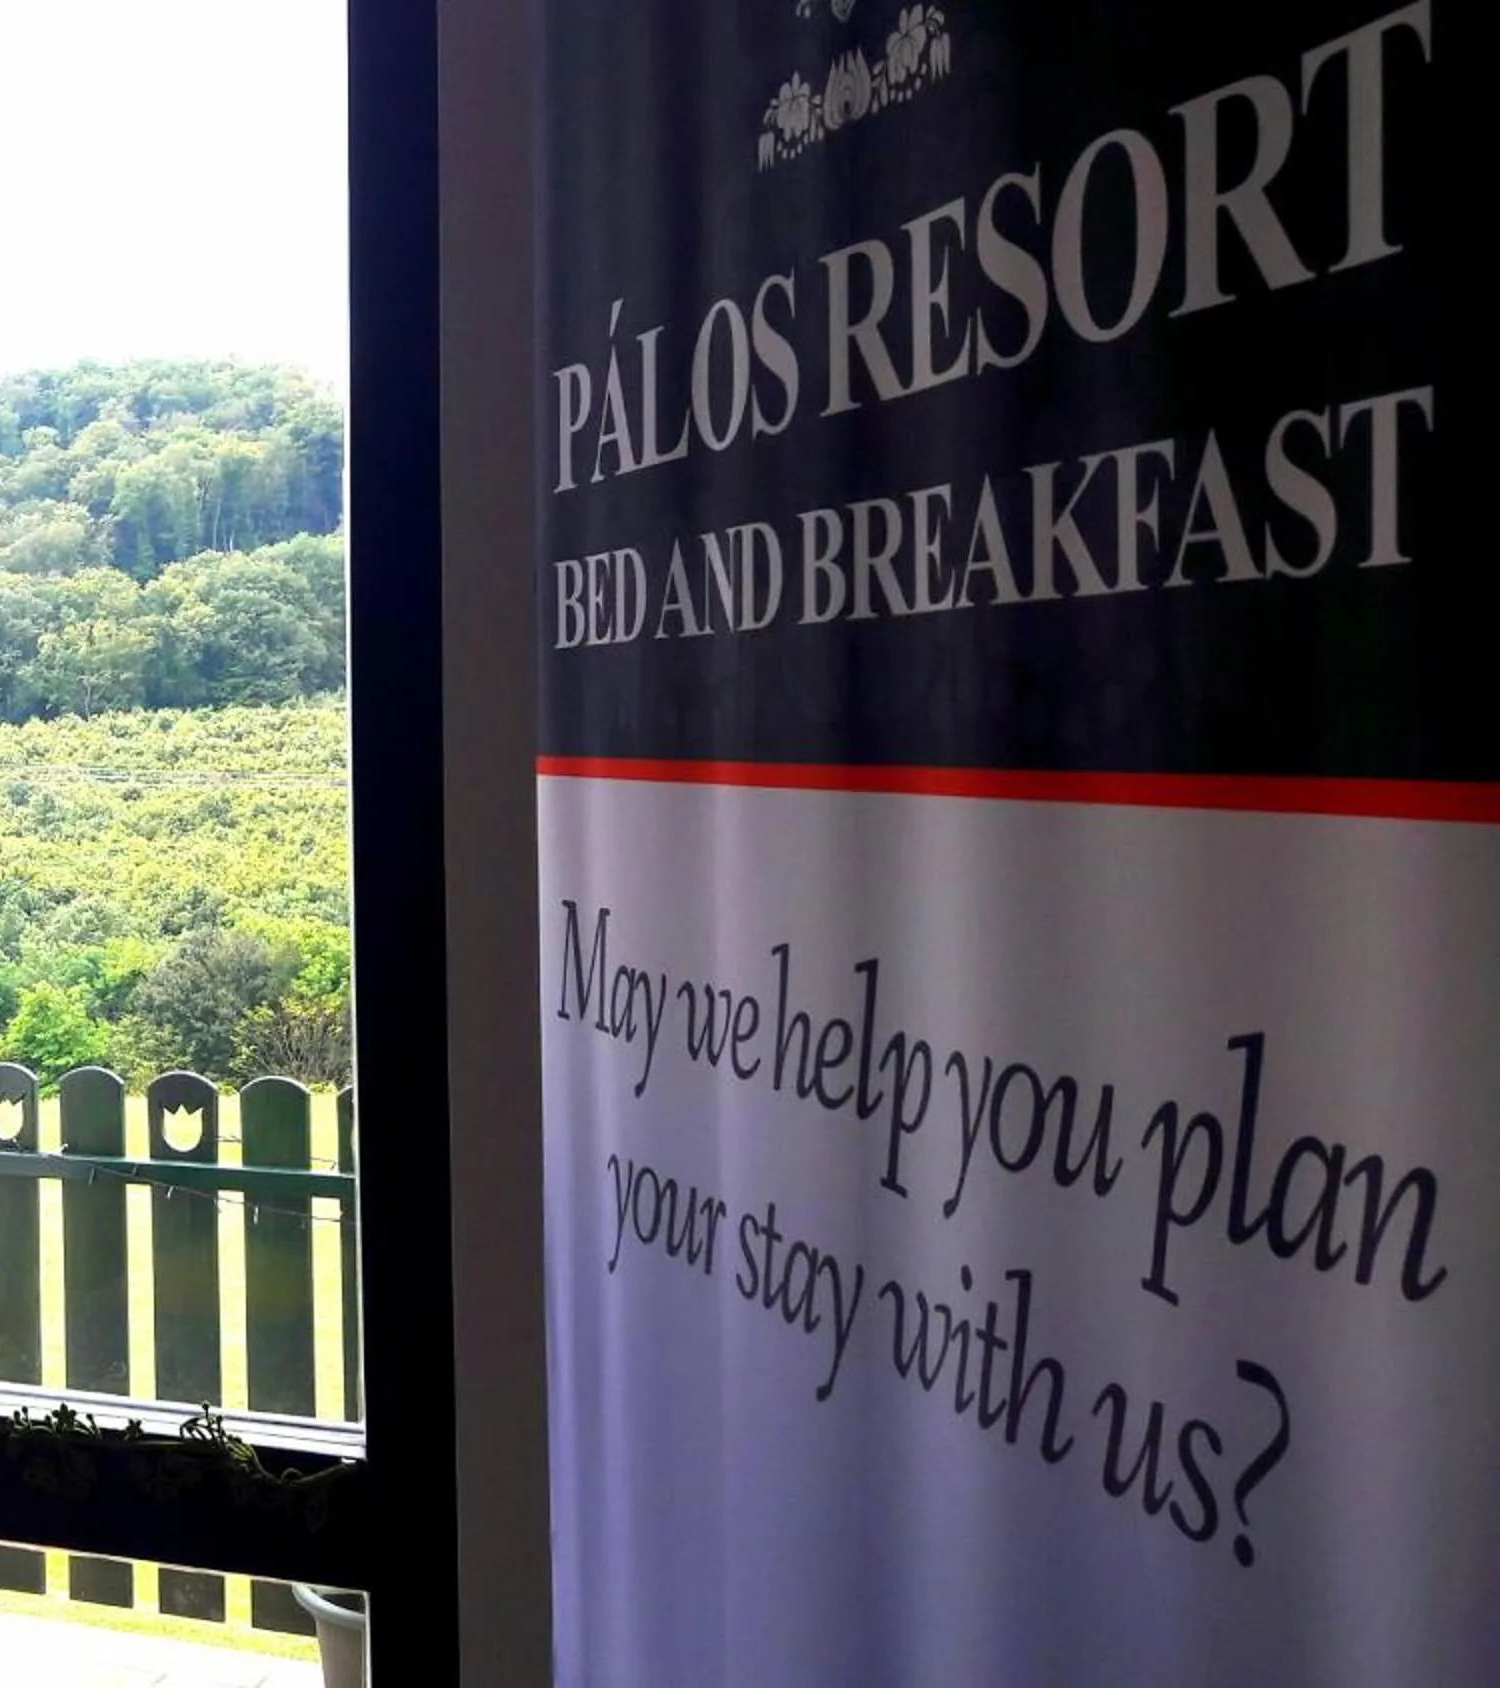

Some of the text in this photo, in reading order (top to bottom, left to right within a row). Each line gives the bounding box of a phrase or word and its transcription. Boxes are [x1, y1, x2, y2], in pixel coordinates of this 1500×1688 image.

[553, 0, 1434, 494] PÁLOS RESORT
[554, 386, 1435, 650] BED AND BREAKFAST
[557, 899, 1449, 1306] May we help you plan
[606, 1152, 1292, 1568] your stay with us?
